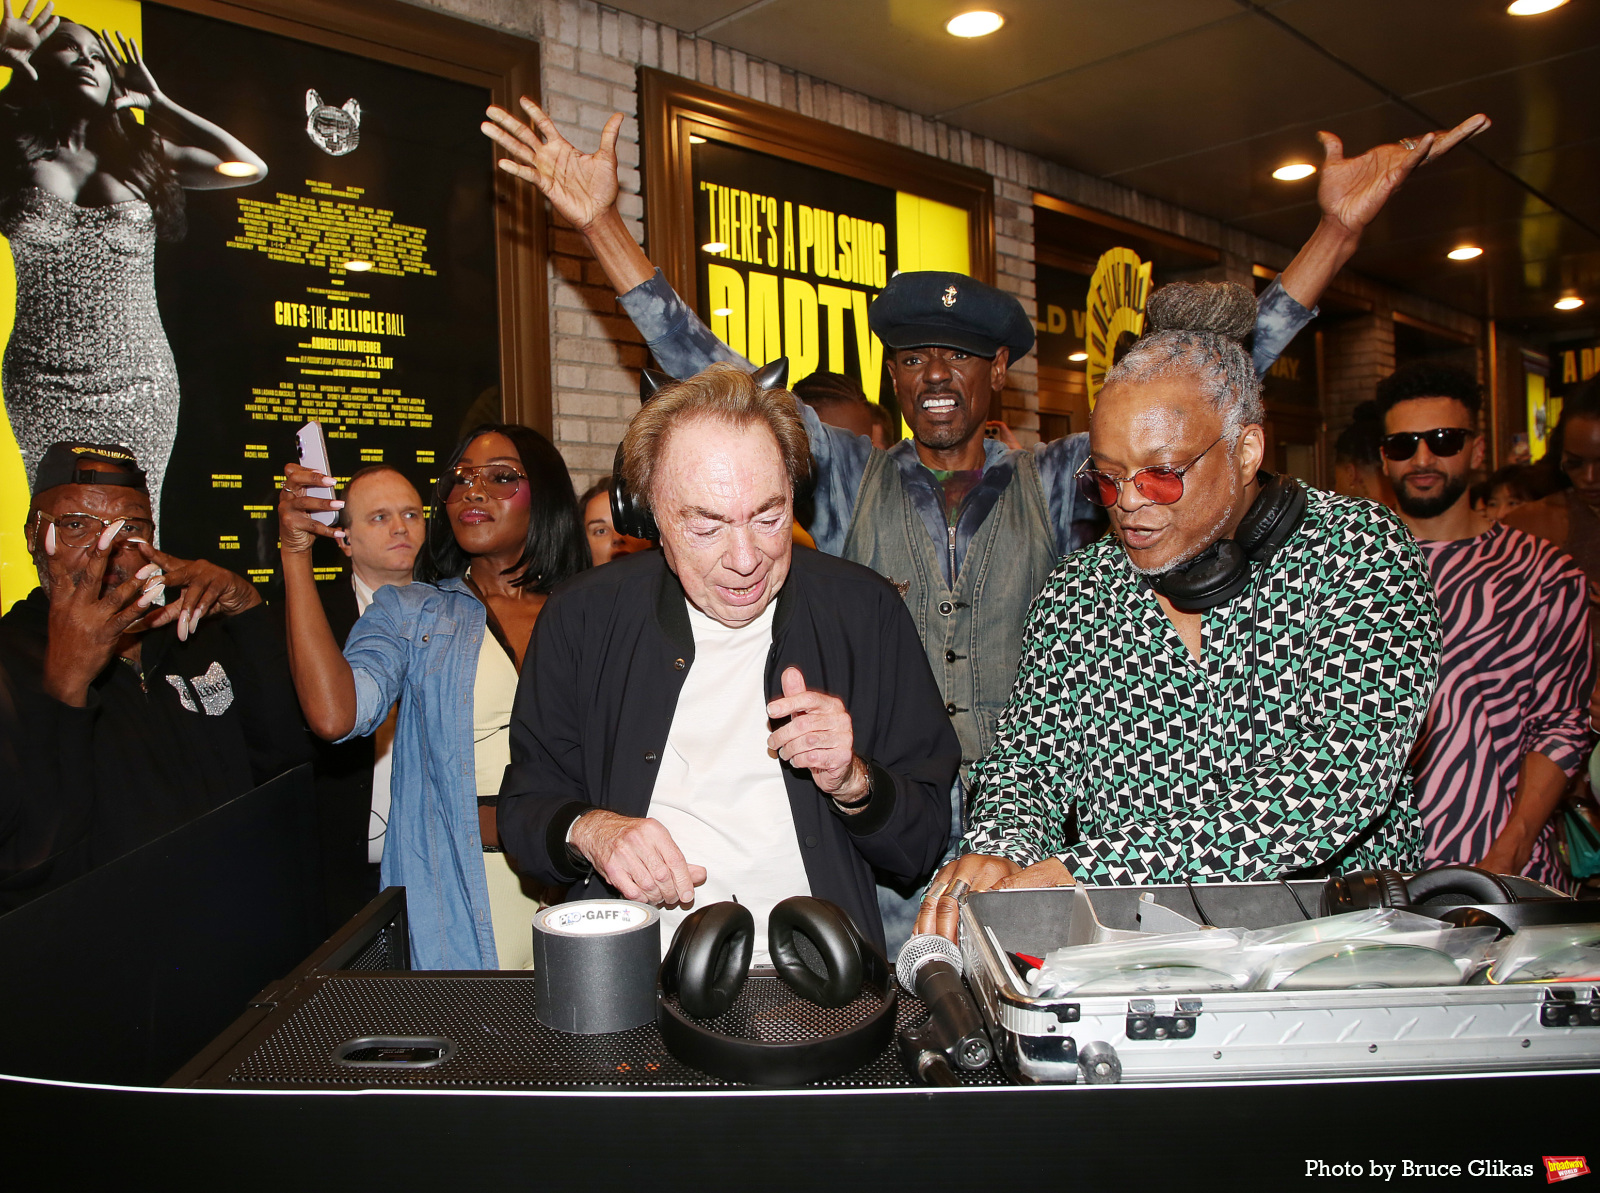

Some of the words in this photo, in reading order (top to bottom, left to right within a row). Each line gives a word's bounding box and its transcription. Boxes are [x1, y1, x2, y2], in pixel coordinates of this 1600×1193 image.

[783, 201, 796, 271] A
[798, 204, 887, 288] PULSING
[328, 307, 385, 335] JELLICLE
[385, 312, 406, 337] BALL
[338, 338, 357, 353] LLOYD
[708, 263, 884, 404] PARTY
